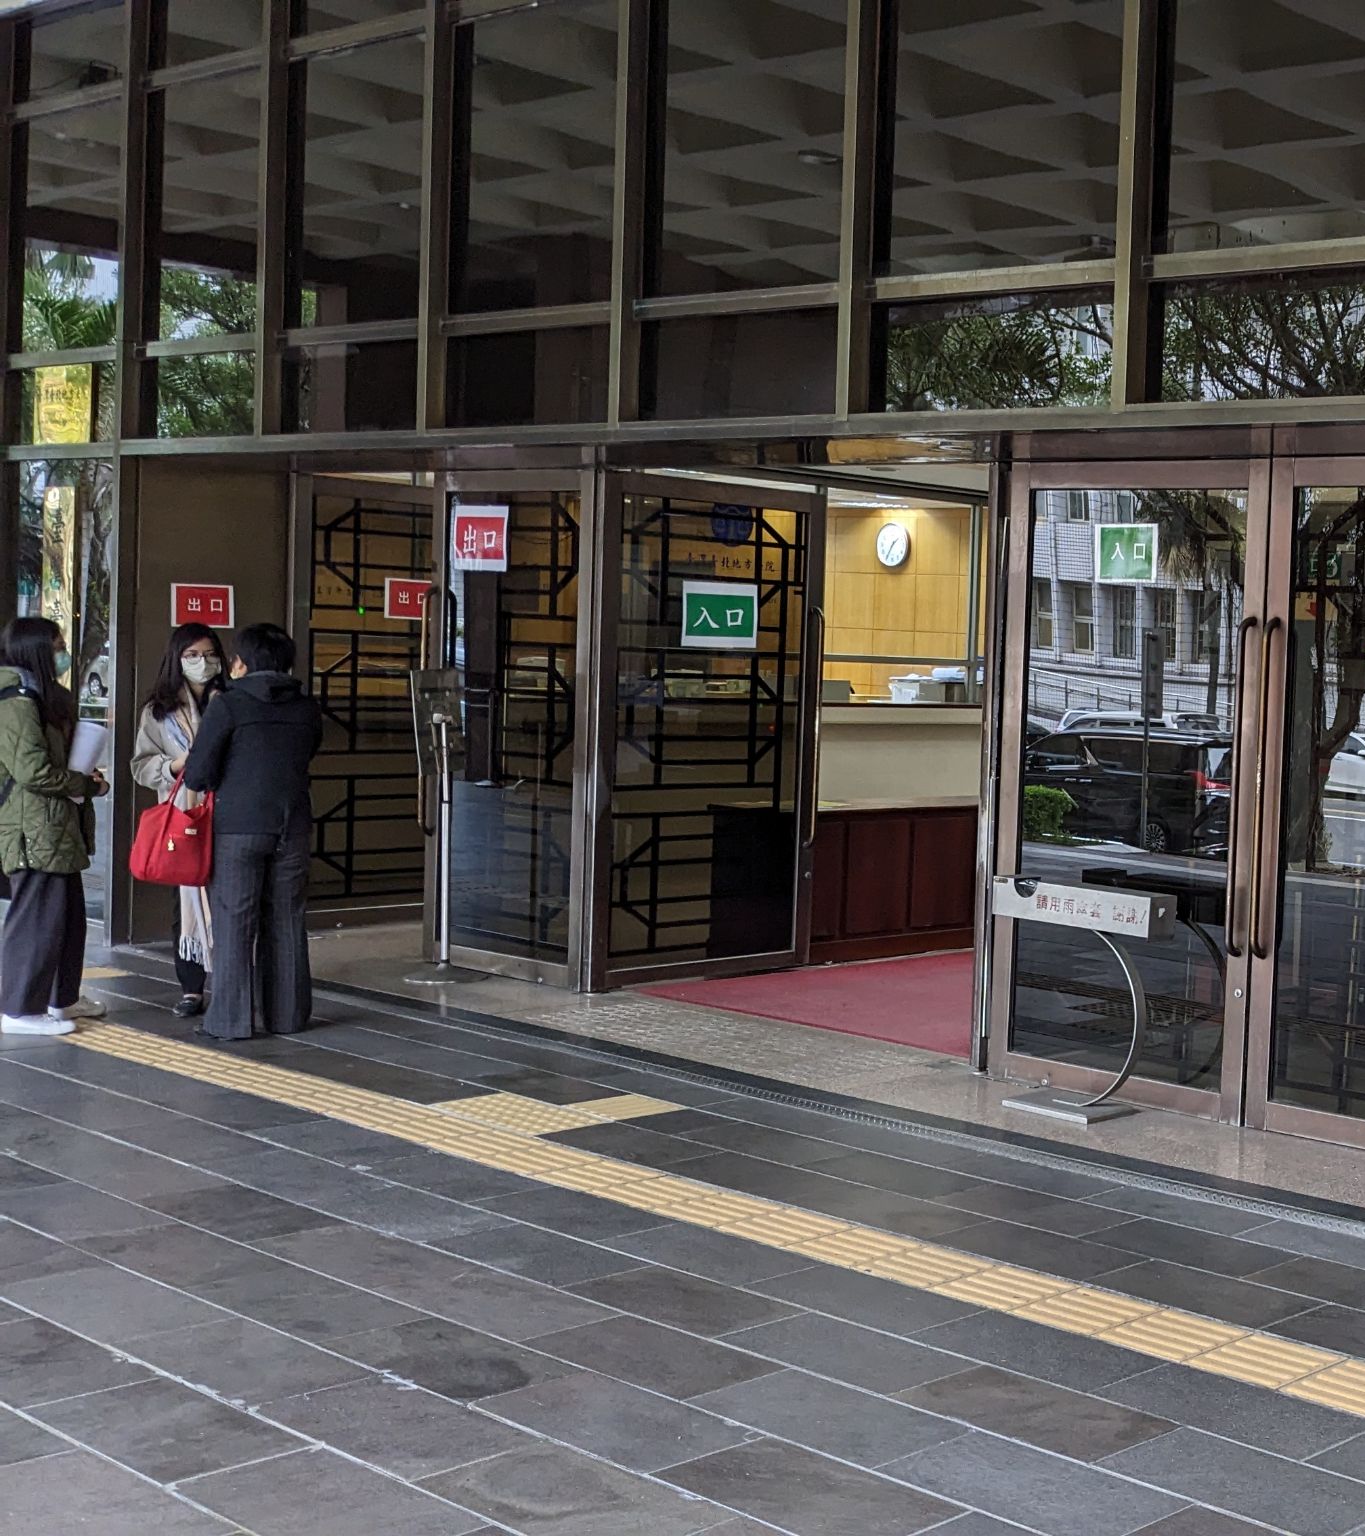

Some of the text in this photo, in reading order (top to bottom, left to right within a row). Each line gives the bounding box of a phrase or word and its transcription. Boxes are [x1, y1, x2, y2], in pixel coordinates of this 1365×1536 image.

[463, 524, 497, 554] 出口
[1110, 542, 1146, 560] 入口
[187, 597, 223, 613] 出口
[398, 591, 425, 605] 出口
[692, 606, 745, 629] 入口
